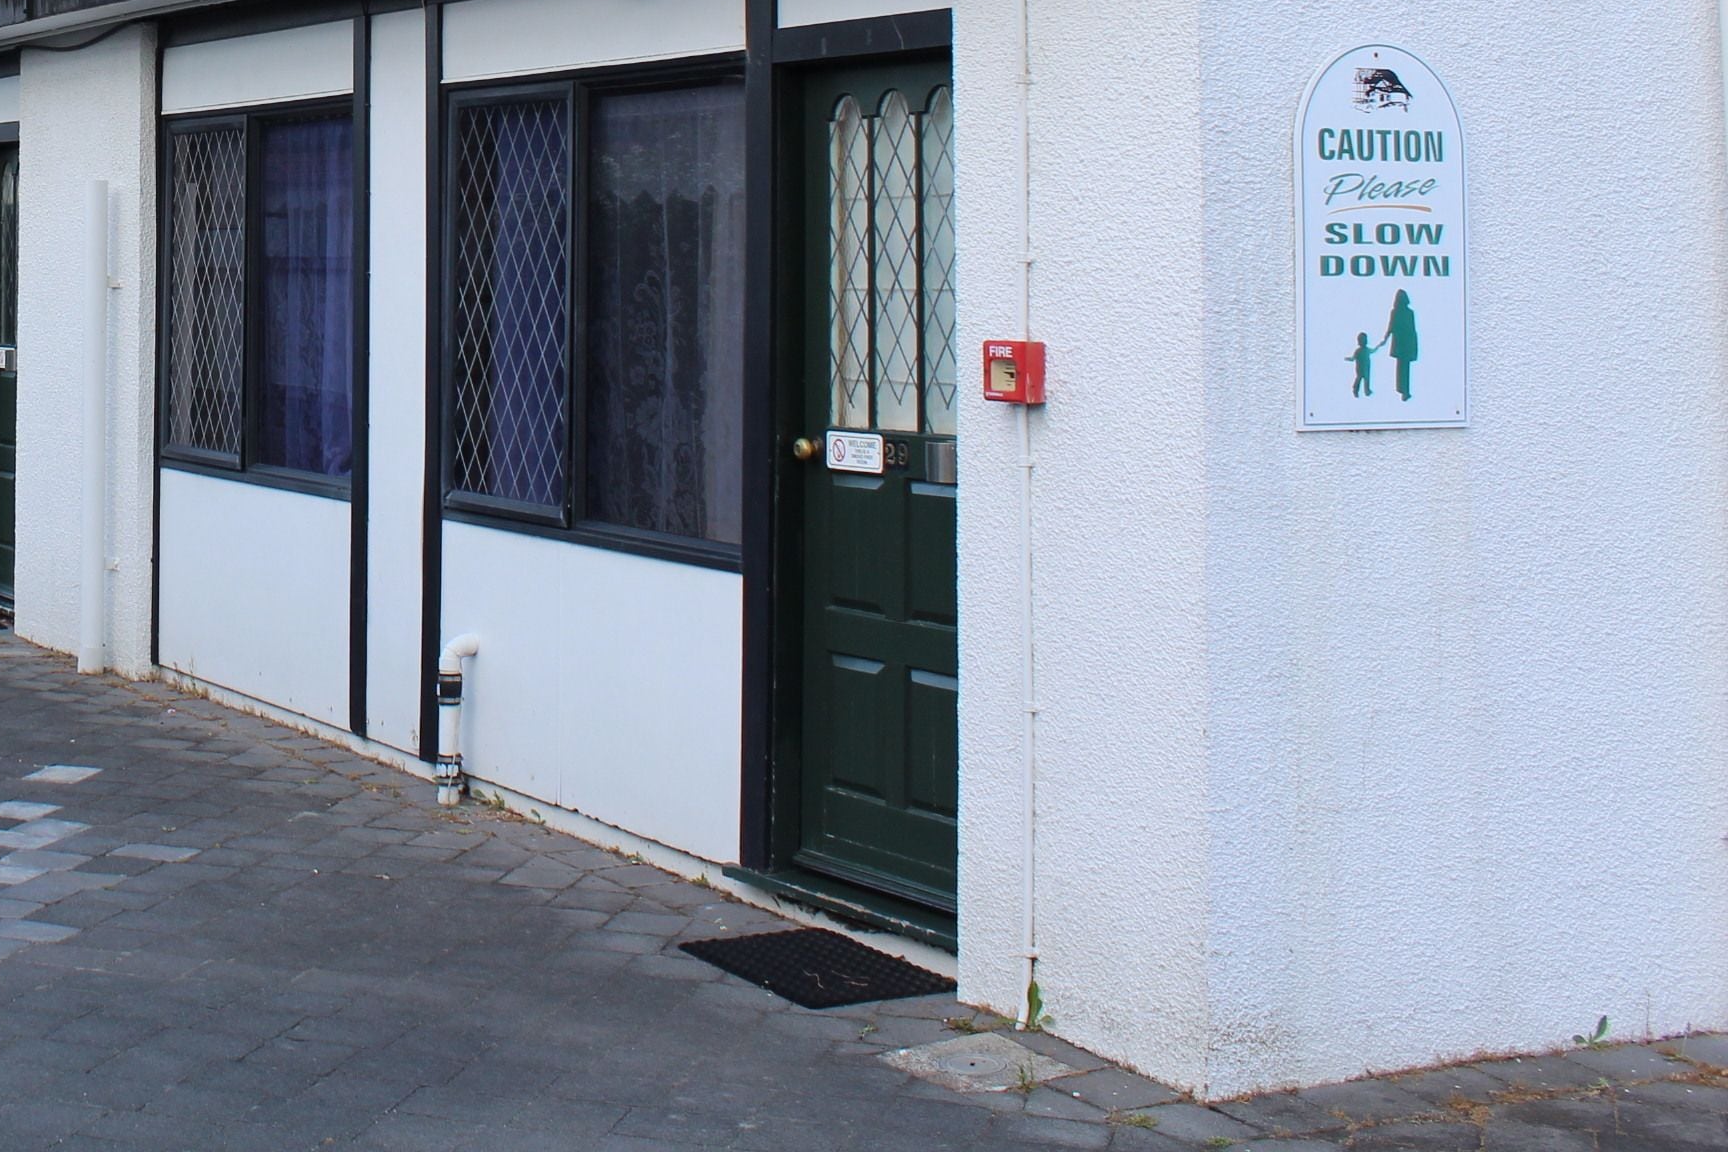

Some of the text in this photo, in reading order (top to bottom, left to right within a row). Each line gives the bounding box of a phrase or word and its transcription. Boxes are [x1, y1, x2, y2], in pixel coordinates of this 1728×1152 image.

[1318, 127, 1445, 162] CAUTION
[1323, 173, 1440, 206] Please
[1324, 222, 1444, 245] SLOW
[1320, 255, 1450, 277] DOWN
[989, 345, 1013, 358] FIRE
